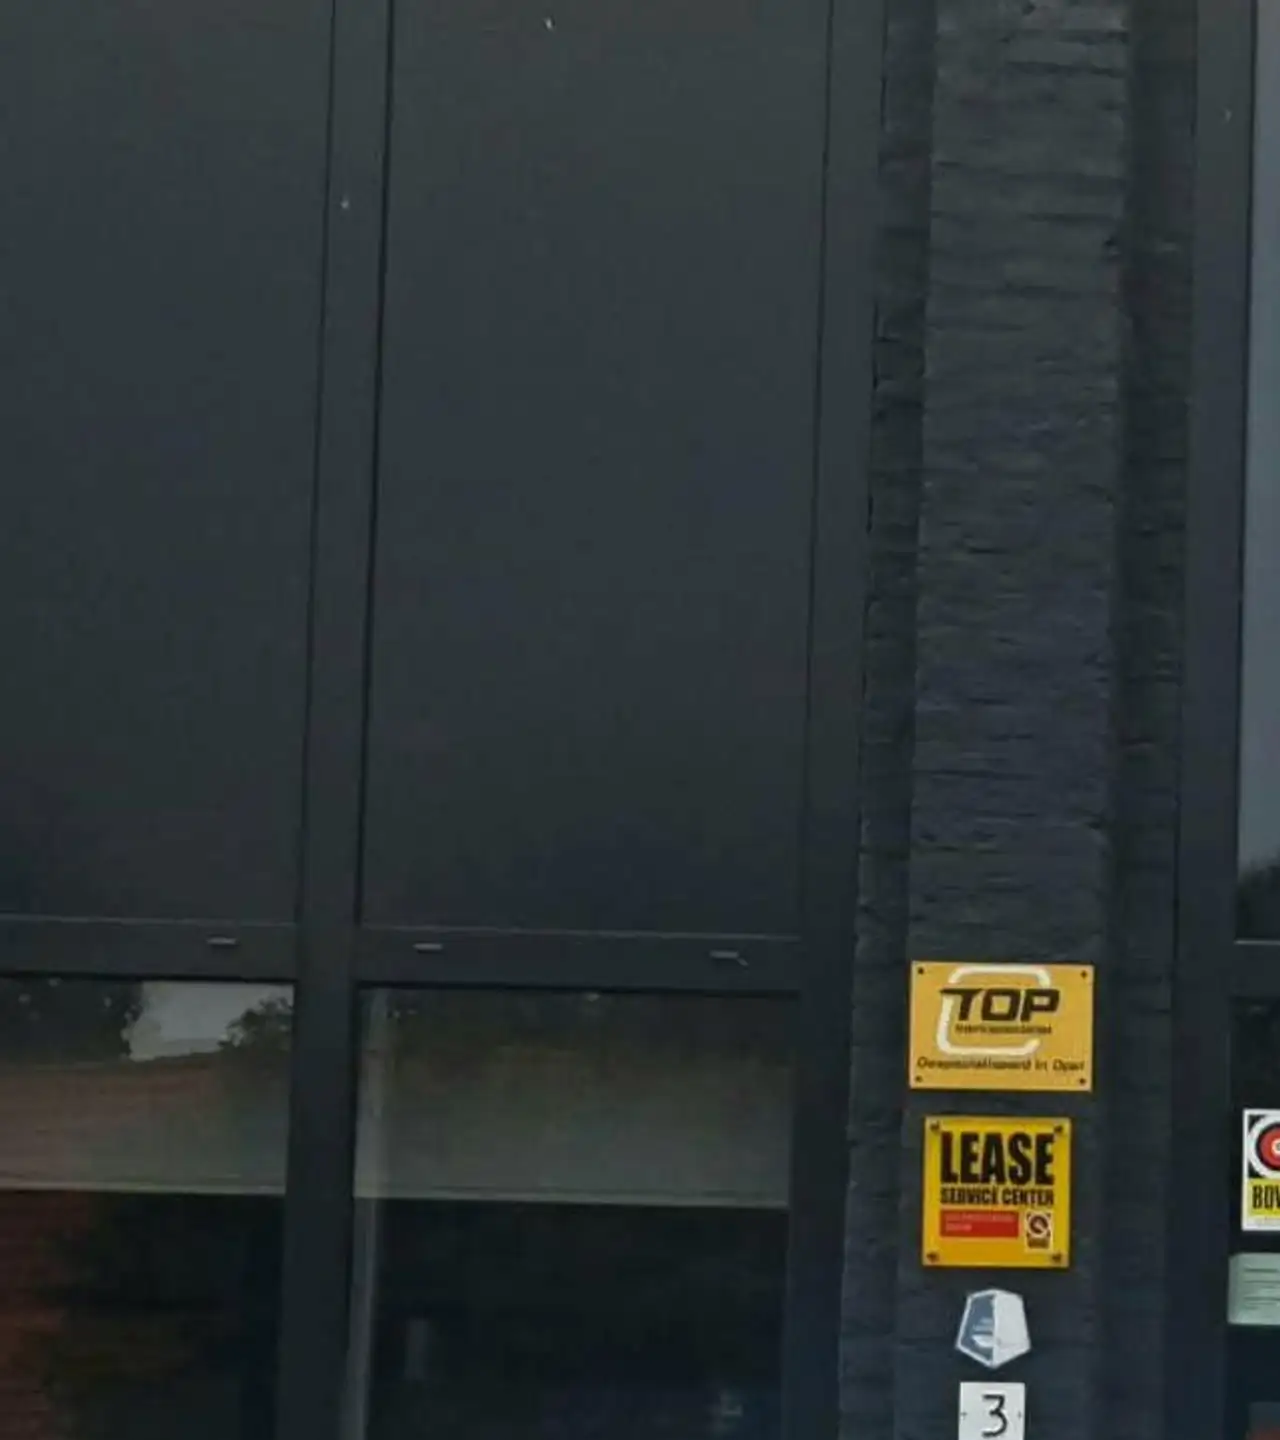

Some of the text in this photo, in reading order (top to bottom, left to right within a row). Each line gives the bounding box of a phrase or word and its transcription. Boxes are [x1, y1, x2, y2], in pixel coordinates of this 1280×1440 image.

[939, 988, 1060, 1021] TOP
[940, 1131, 1055, 1185] LEASE
[940, 1186, 1055, 1206] SERVICE CENTER
[981, 1394, 1007, 1437] 3
